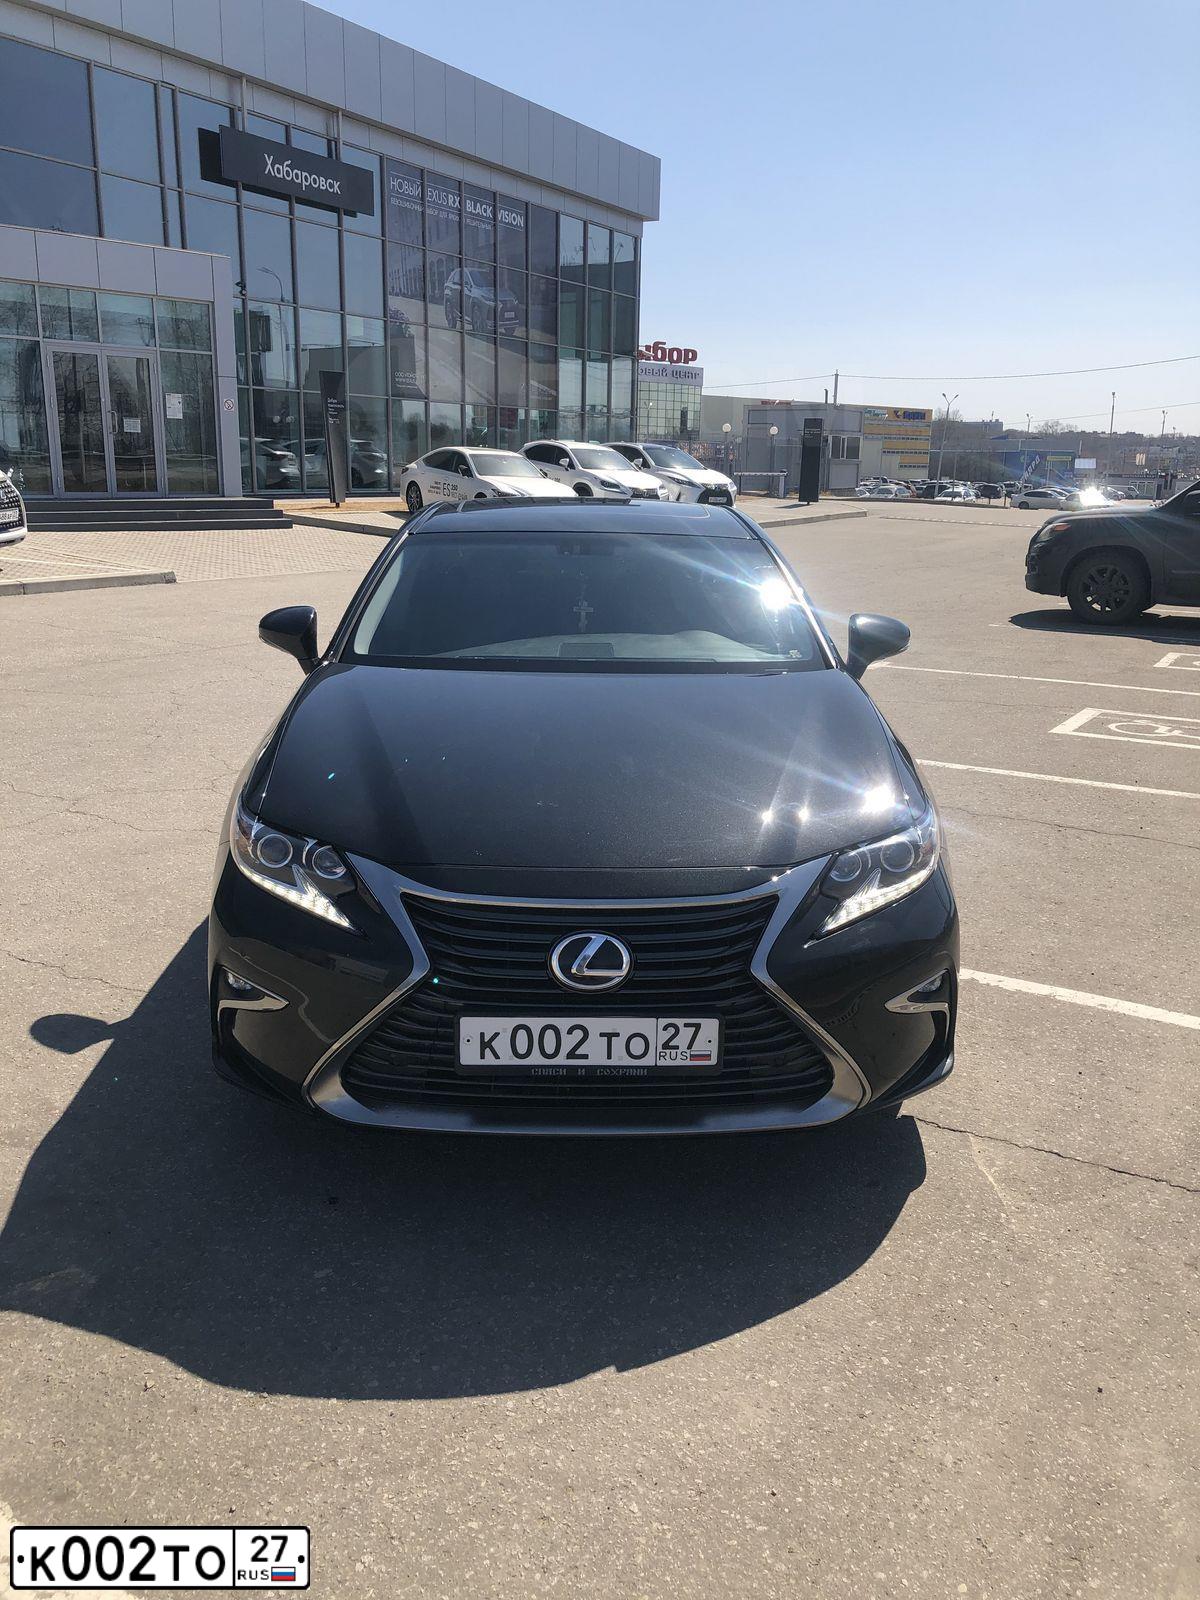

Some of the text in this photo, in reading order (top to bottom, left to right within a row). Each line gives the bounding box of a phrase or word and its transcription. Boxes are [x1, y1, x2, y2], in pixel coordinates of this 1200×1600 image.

[263, 153, 342, 195] Хабаровск
[390, 176, 524, 227] НОВЫЙ EXUS RX BLACK VISION
[479, 1022, 702, 1060] К002ТО 27
[658, 1050, 688, 1061] RUS
